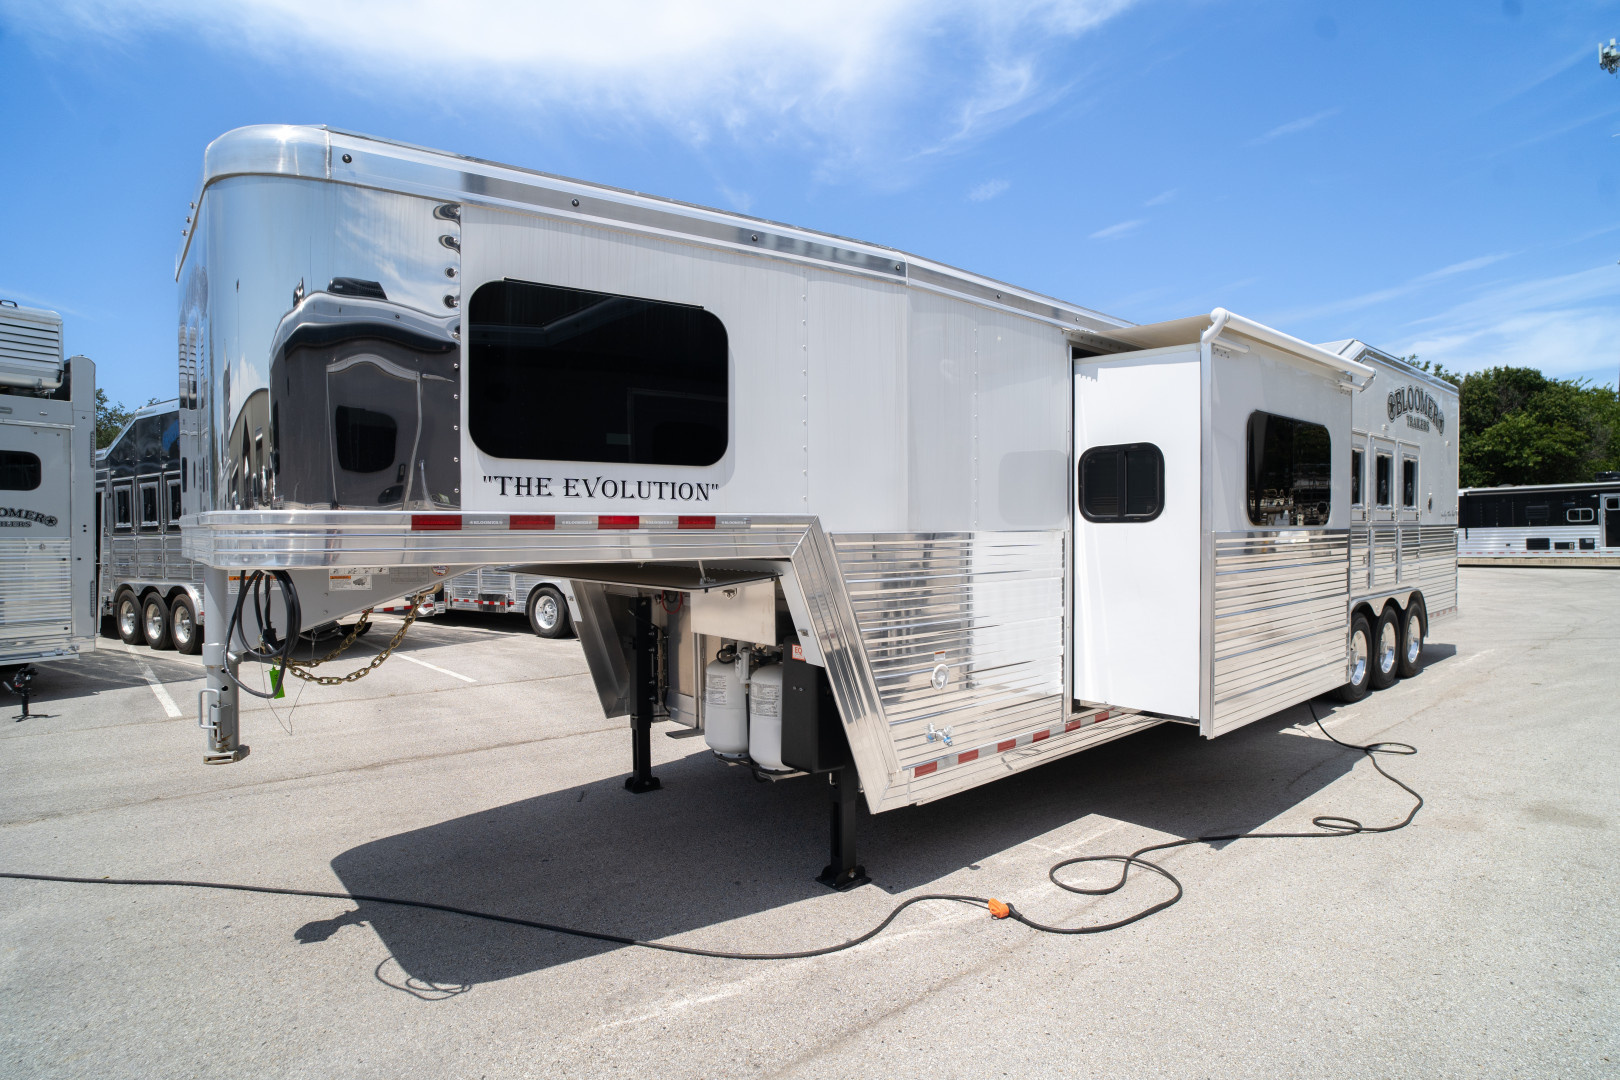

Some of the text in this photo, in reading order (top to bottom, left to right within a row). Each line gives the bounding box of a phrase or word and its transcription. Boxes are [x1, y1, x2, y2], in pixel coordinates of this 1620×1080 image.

[1394, 385, 1440, 431] BLOOMER
[1405, 414, 1430, 433] TRAILERS
[483, 475, 720, 502] "THE EVOLUTION"
